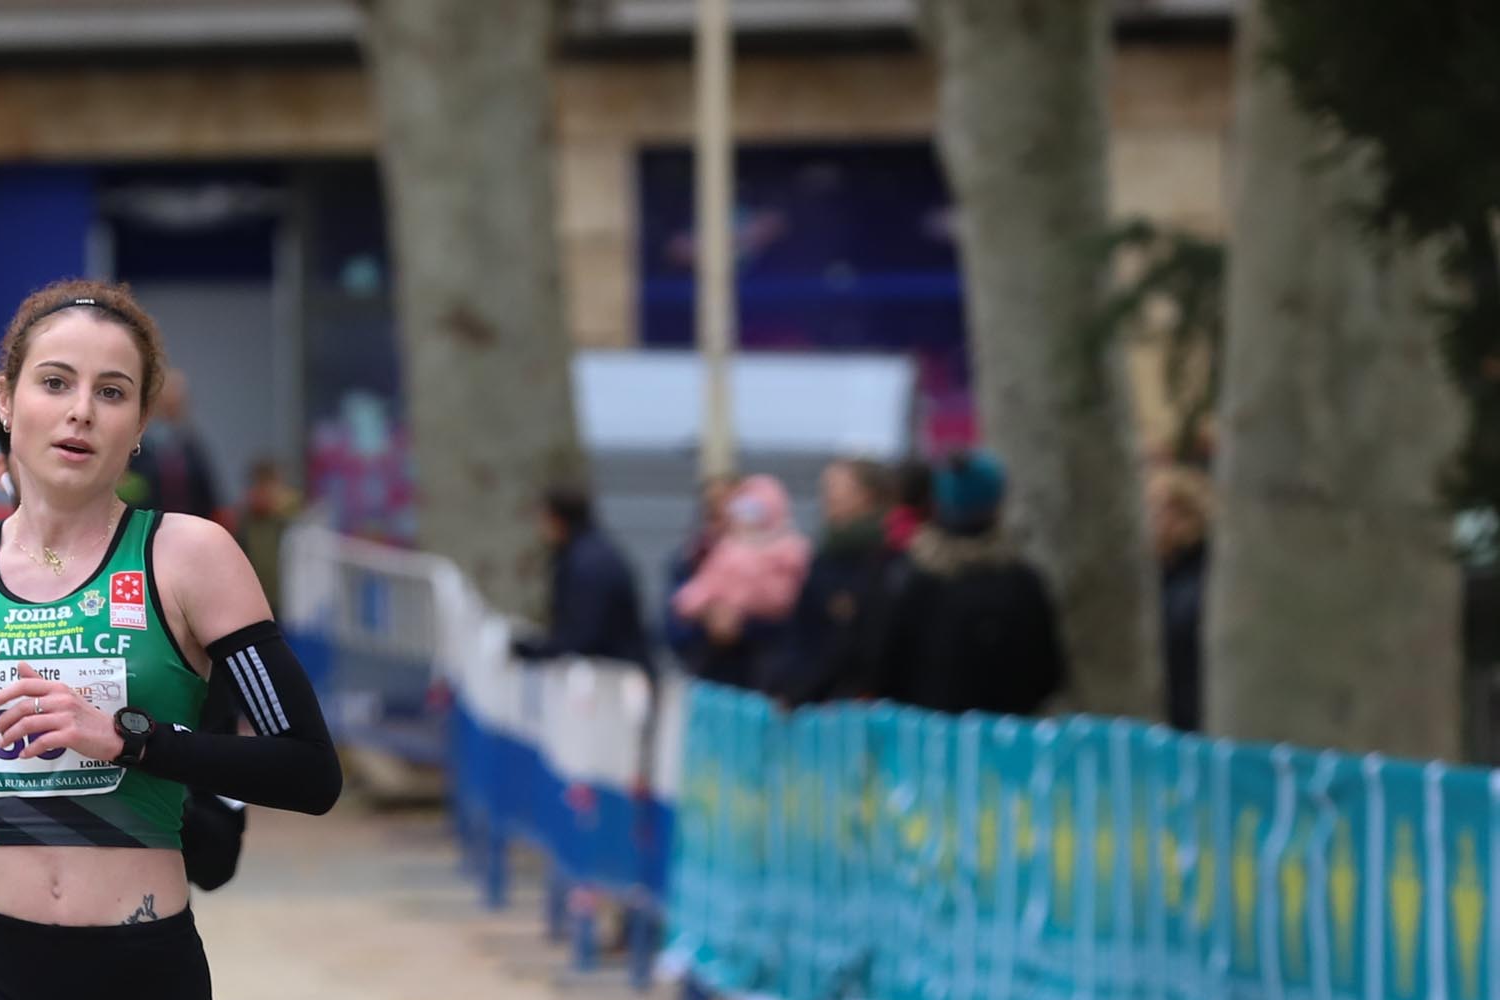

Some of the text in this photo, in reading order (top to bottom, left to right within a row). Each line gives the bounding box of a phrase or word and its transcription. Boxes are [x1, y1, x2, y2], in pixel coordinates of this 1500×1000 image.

[4, 622, 56, 631] Ayuntamiento
[27, 630, 37, 638] de
[94, 633, 131, 655] C.F
[4, 779, 37, 788] RURAL
[40, 778, 53, 787] DE
